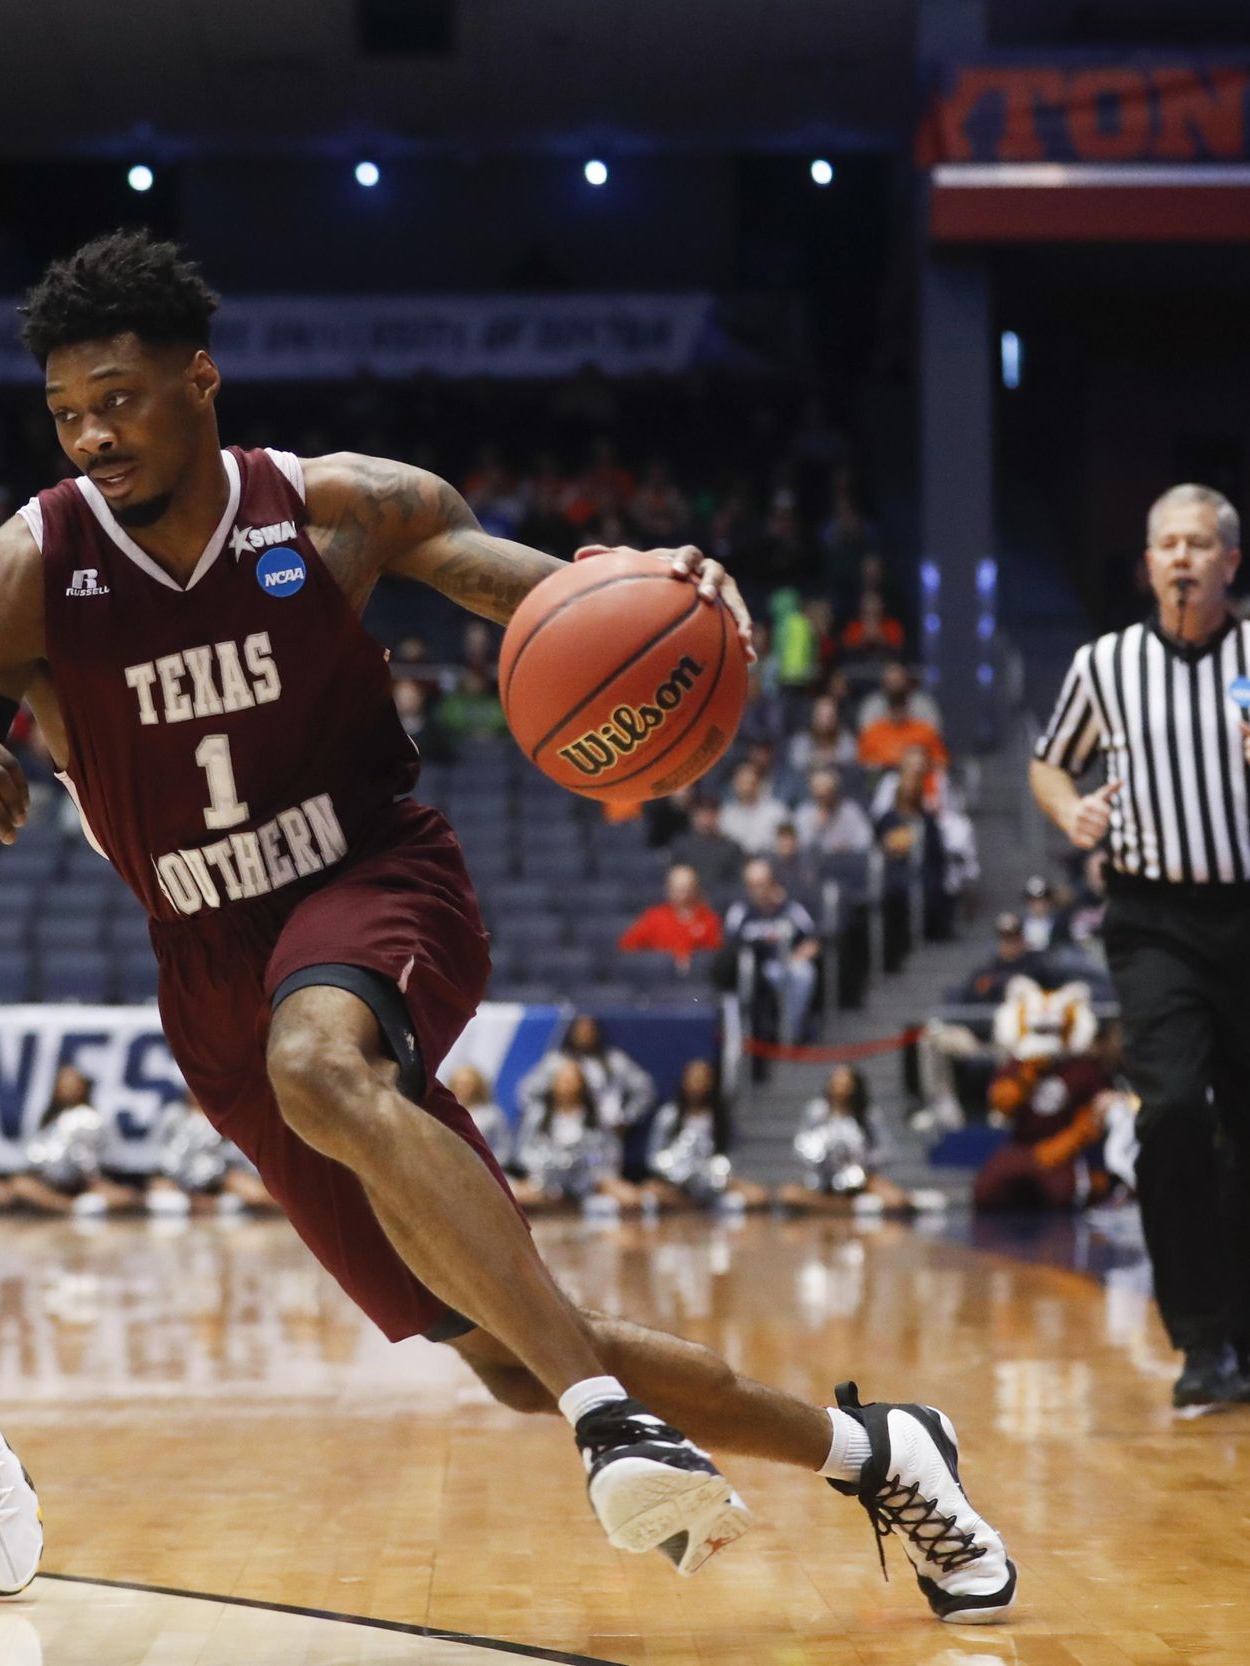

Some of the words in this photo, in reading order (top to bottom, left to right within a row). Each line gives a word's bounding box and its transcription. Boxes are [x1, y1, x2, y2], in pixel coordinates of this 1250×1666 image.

[65, 585, 111, 597] RUSSELL
[264, 567, 305, 588] NCAA
[124, 631, 282, 725] TEXAS
[557, 655, 706, 776] Wilson
[195, 733, 250, 830] 1
[151, 792, 348, 916] OUTHERN
